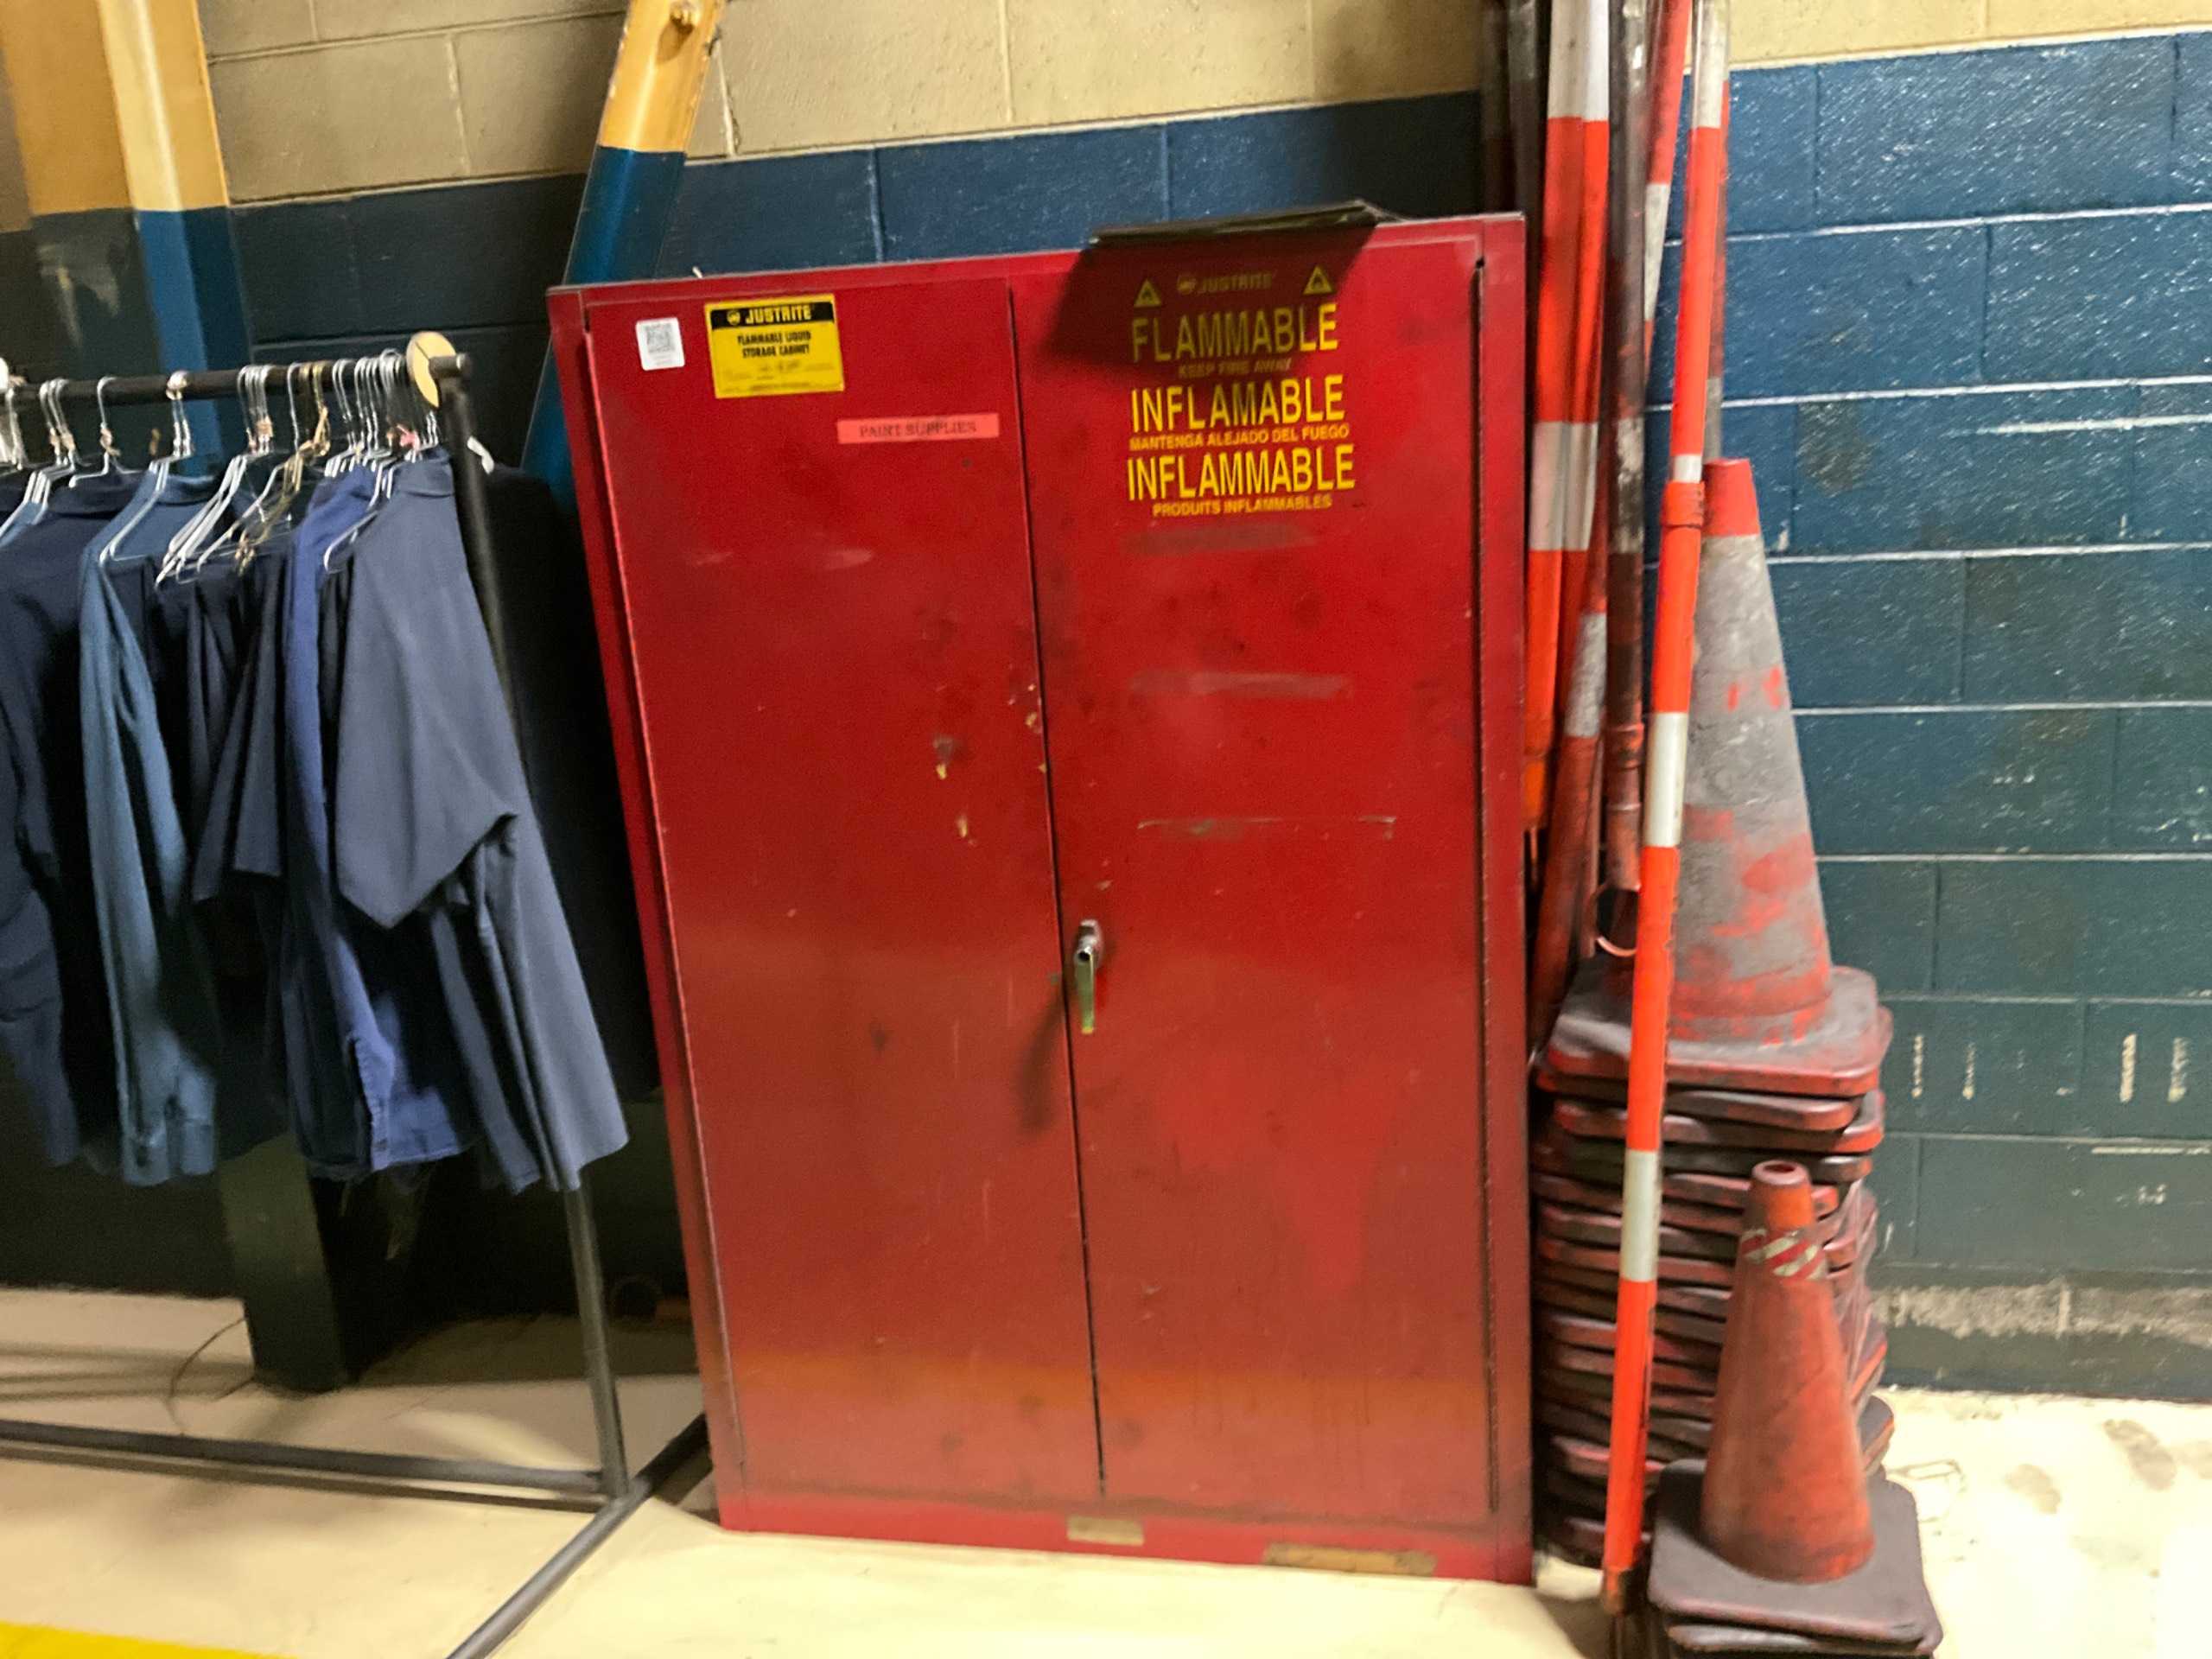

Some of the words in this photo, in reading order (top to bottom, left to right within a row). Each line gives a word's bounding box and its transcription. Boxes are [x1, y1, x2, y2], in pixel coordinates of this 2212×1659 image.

[745, 304, 812, 325] JUSTRITE
[737, 331, 783, 346] FLAMMABLE
[785, 330, 811, 343] LIQUID
[1131, 302, 1339, 363] FLAMMABLE
[742, 345, 777, 359] STORAGE
[779, 343, 810, 356] CABINET
[1130, 373, 1345, 433] INFLAMABLE
[1128, 432, 1205, 452] MANTENGA
[1206, 427, 1270, 448] ALEJADO
[1272, 425, 1300, 443] DEL
[1301, 423, 1350, 441] FUEGO
[1127, 443, 1356, 501] INFLAMMABLE
[1152, 498, 1221, 518] PRODUITS
[1223, 493, 1333, 514] INFLAMMABLES
